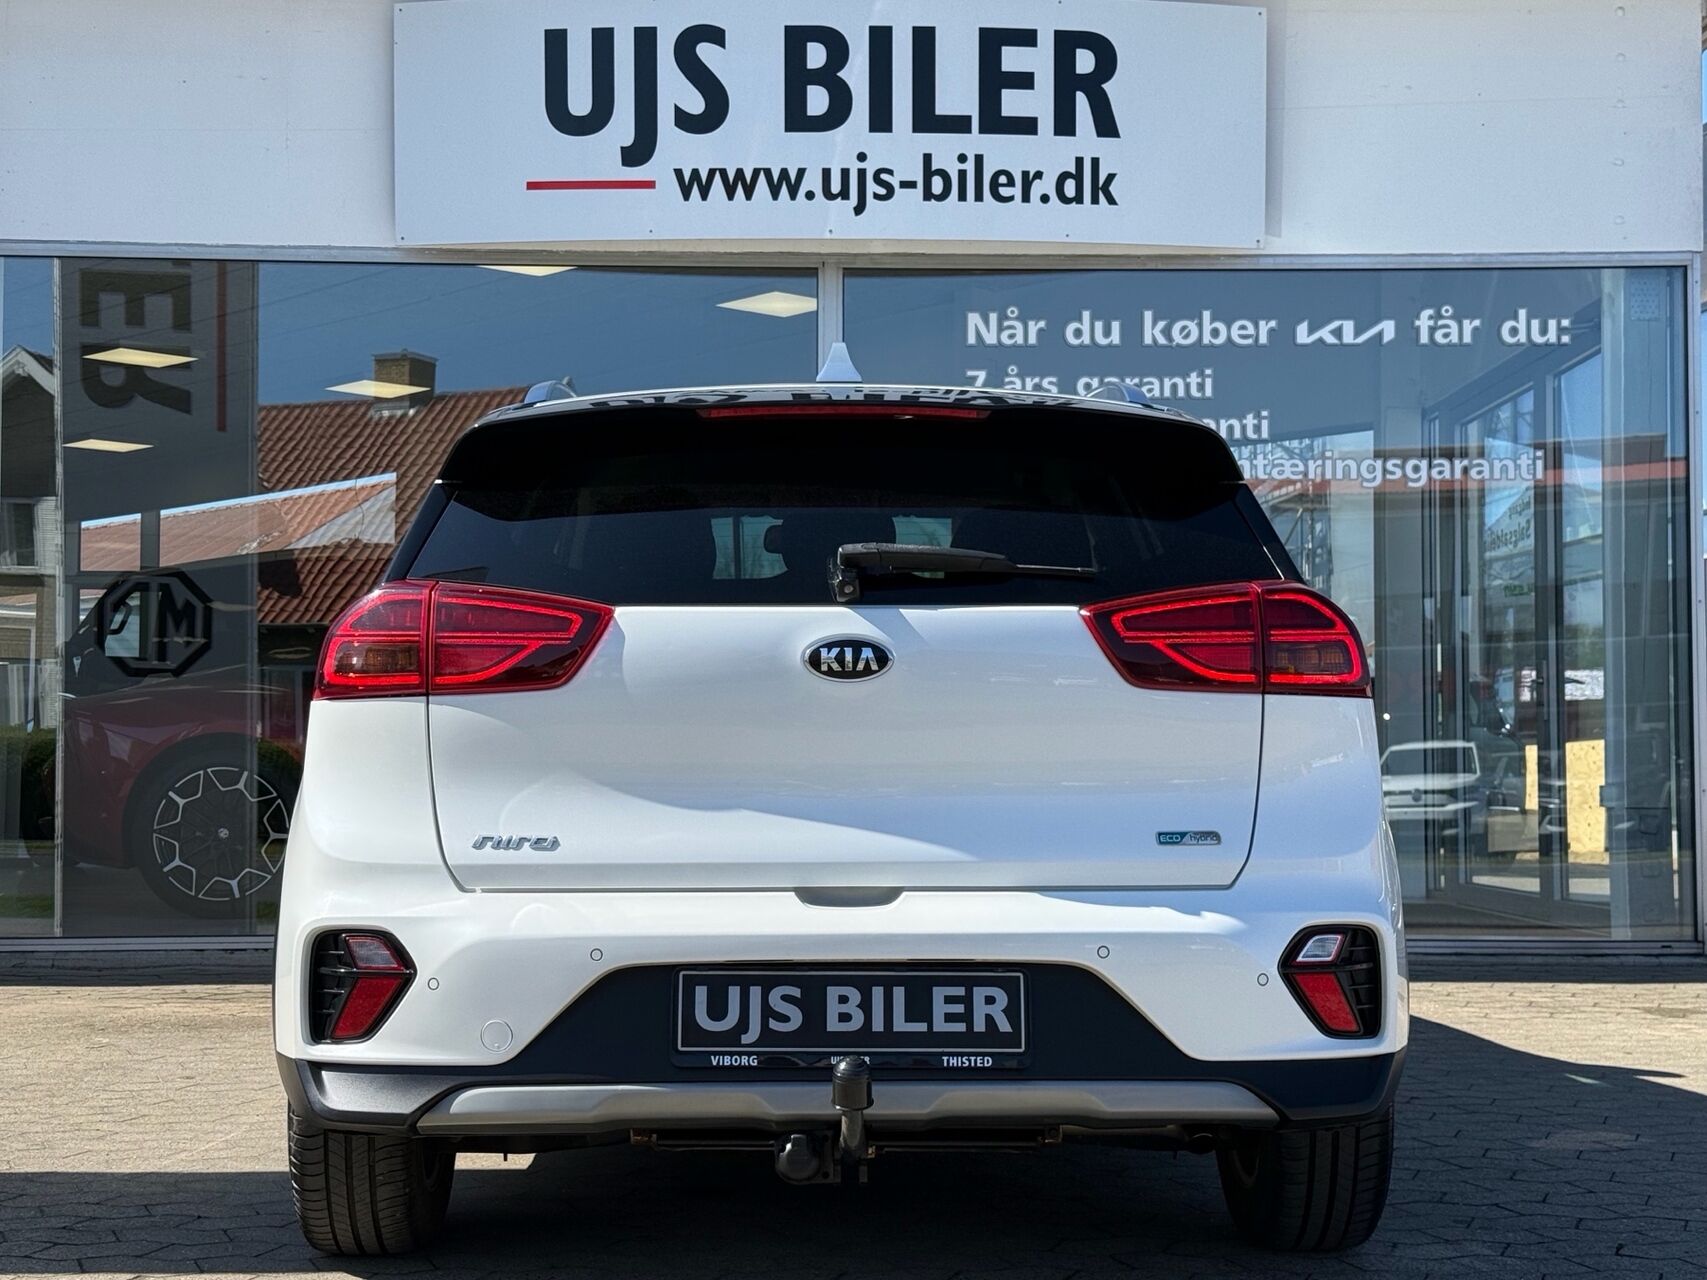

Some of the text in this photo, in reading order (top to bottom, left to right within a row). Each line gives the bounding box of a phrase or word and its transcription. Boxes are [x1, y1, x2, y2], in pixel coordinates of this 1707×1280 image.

[543, 24, 1121, 168] UJS BILER
[673, 152, 1119, 216] www.ujs-biler.dk
[966, 307, 1046, 347] Når
[1065, 309, 1121, 347] du
[1142, 309, 1277, 347] køber
[1414, 306, 1481, 346] får
[1501, 308, 1572, 347] du:
[966, 370, 987, 387] 7
[1004, 365, 1058, 394] års
[819, 647, 879, 671] KIA
[1159, 834, 1181, 842] ECO
[694, 985, 1013, 1045] UJS BILER
[711, 1055, 758, 1066] VIBORG
[942, 1056, 993, 1067] THISTED
